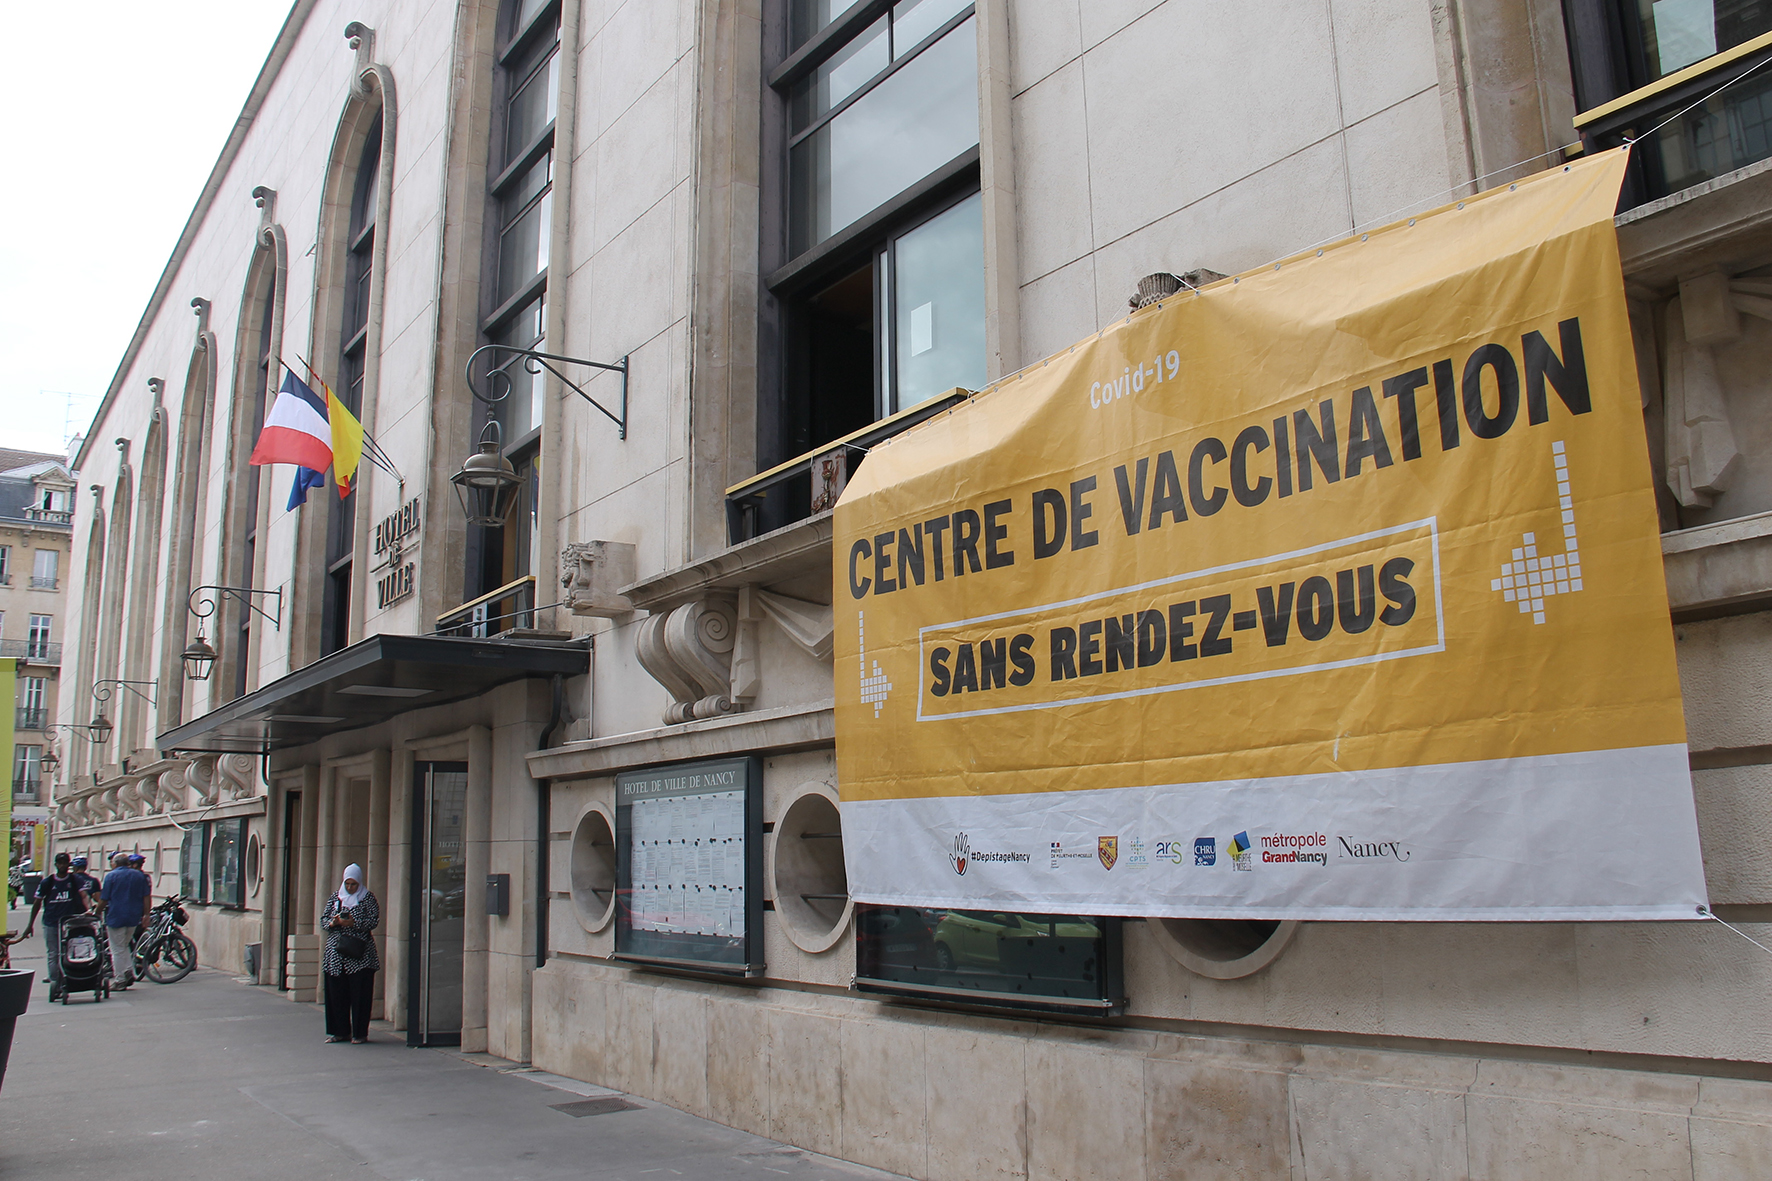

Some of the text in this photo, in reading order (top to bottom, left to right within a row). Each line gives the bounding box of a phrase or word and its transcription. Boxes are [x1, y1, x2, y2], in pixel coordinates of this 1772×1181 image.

[1089, 350, 1180, 410] Covid-19
[849, 316, 1592, 600] CENTRE DE VACCINATION
[374, 498, 420, 555] HOTEL
[388, 545, 401, 568] DE
[378, 562, 414, 609] VILLE
[930, 557, 1417, 697] SANS RENDEZ-VOUS
[624, 771, 736, 795] HOTEL DE VILLE DE NANCY
[1194, 845, 1216, 855] CHRU
[1261, 832, 1327, 849] métropole
[1337, 836, 1410, 862] Nancy
[971, 851, 1030, 863] #DepistageNancy
